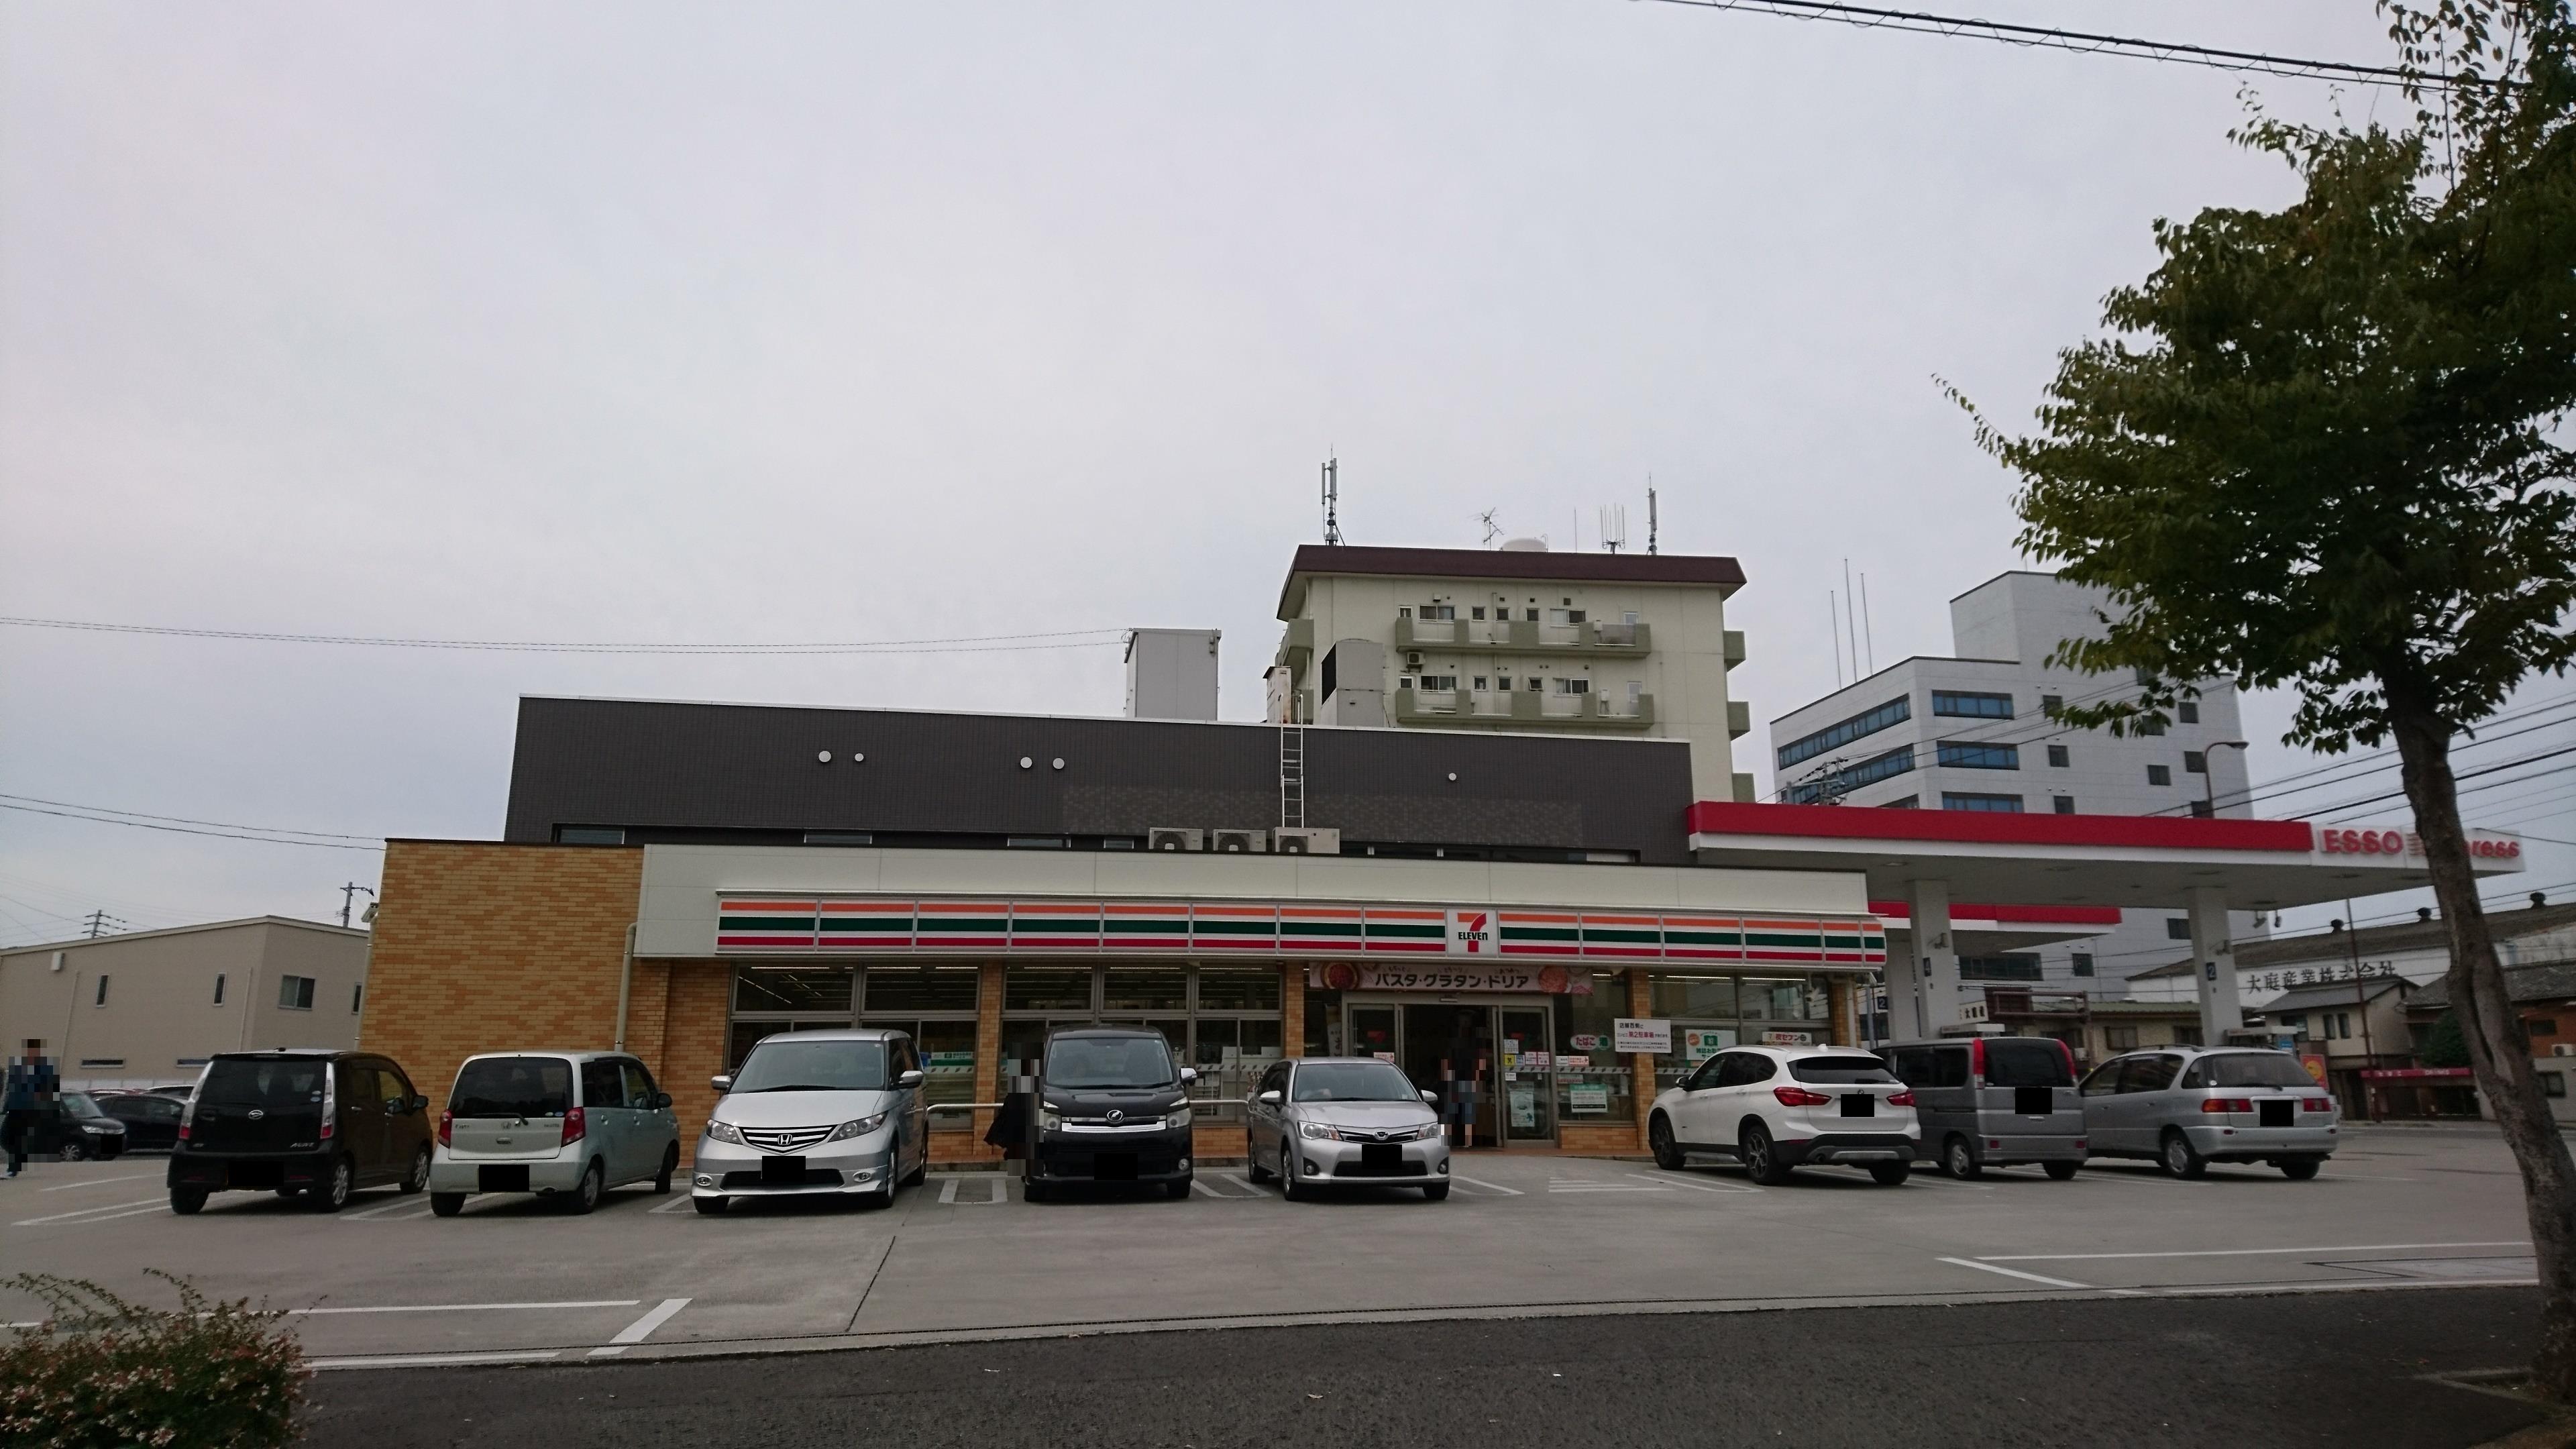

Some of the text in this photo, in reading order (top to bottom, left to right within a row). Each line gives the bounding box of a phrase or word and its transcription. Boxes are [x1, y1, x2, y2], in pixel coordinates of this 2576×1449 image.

[2322, 828, 2404, 855] ESSO
[2208, 965, 2216, 977] 2
[1878, 998, 1886, 1008] 2
[1576, 1036, 1597, 1046] たばこ
